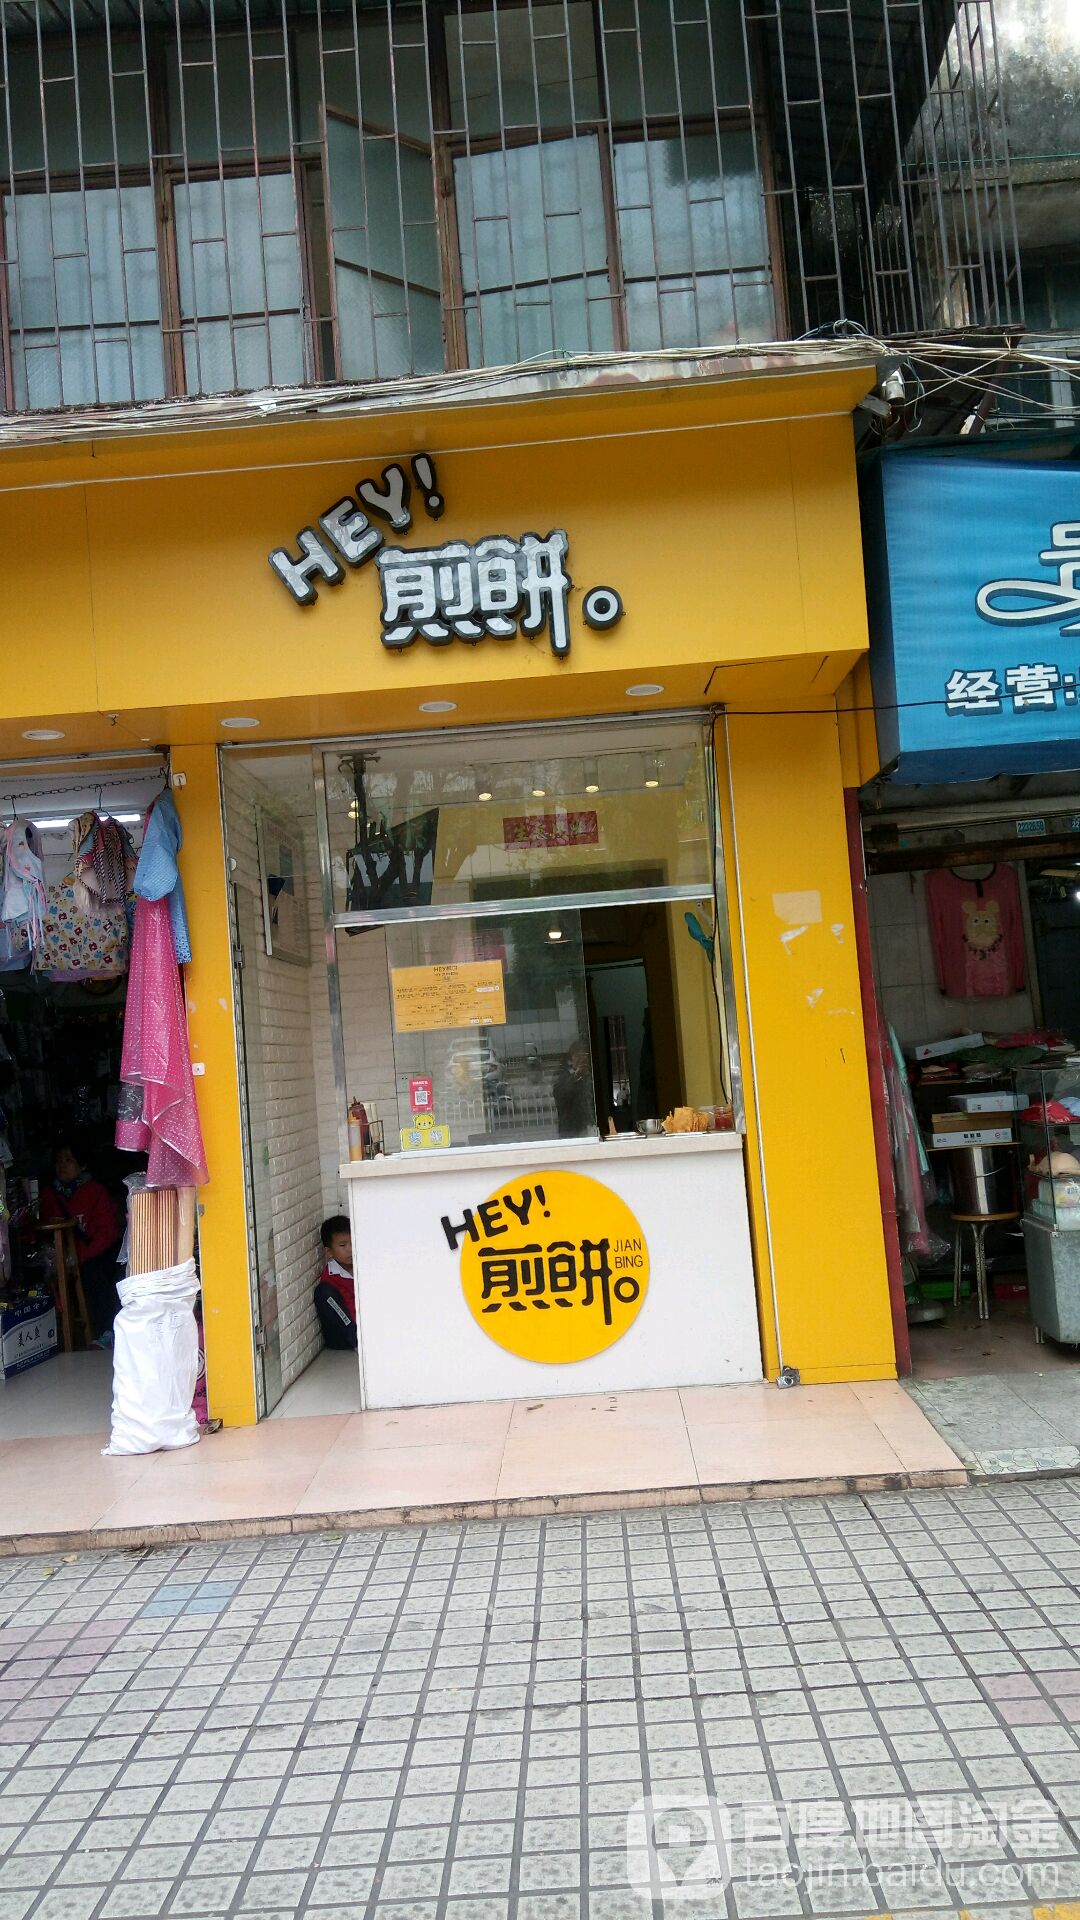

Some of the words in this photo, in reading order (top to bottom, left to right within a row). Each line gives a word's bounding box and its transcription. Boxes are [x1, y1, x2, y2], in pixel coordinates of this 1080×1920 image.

[268, 453, 445, 606] HEY!
[441, 1185, 551, 1250] HEY!
[614, 1239, 642, 1251] JIAN
[615, 1256, 644, 1268] BING
